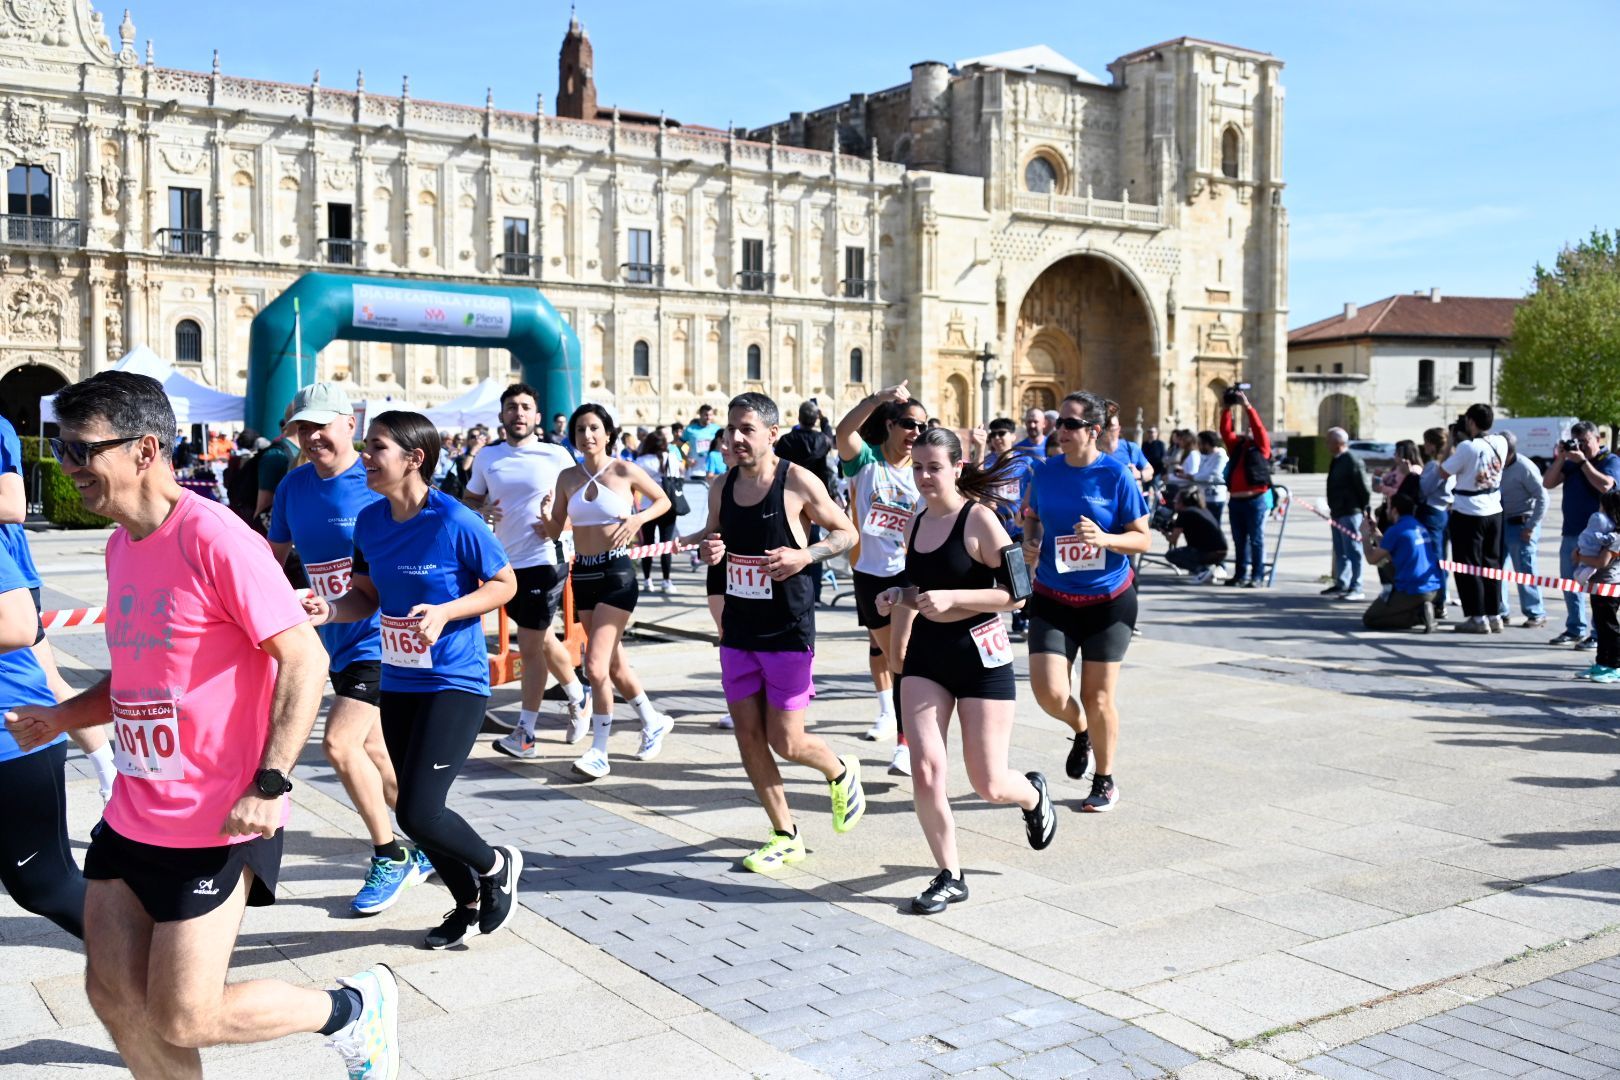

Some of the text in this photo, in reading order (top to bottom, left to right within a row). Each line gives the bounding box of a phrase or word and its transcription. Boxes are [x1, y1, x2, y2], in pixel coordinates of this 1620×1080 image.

[384, 291, 402, 301] DE
[404, 292, 461, 306] CASTILLA
[463, 298, 471, 307] Y
[475, 312, 503, 324] Plena
[581, 552, 606, 566] NIKE
[1059, 543, 1102, 561] 1027
[313, 571, 353, 595] 1162
[729, 566, 767, 586] 1117
[382, 629, 427, 654] 1163
[148, 706, 171, 716] LEÓN
[115, 721, 175, 758] 1010
